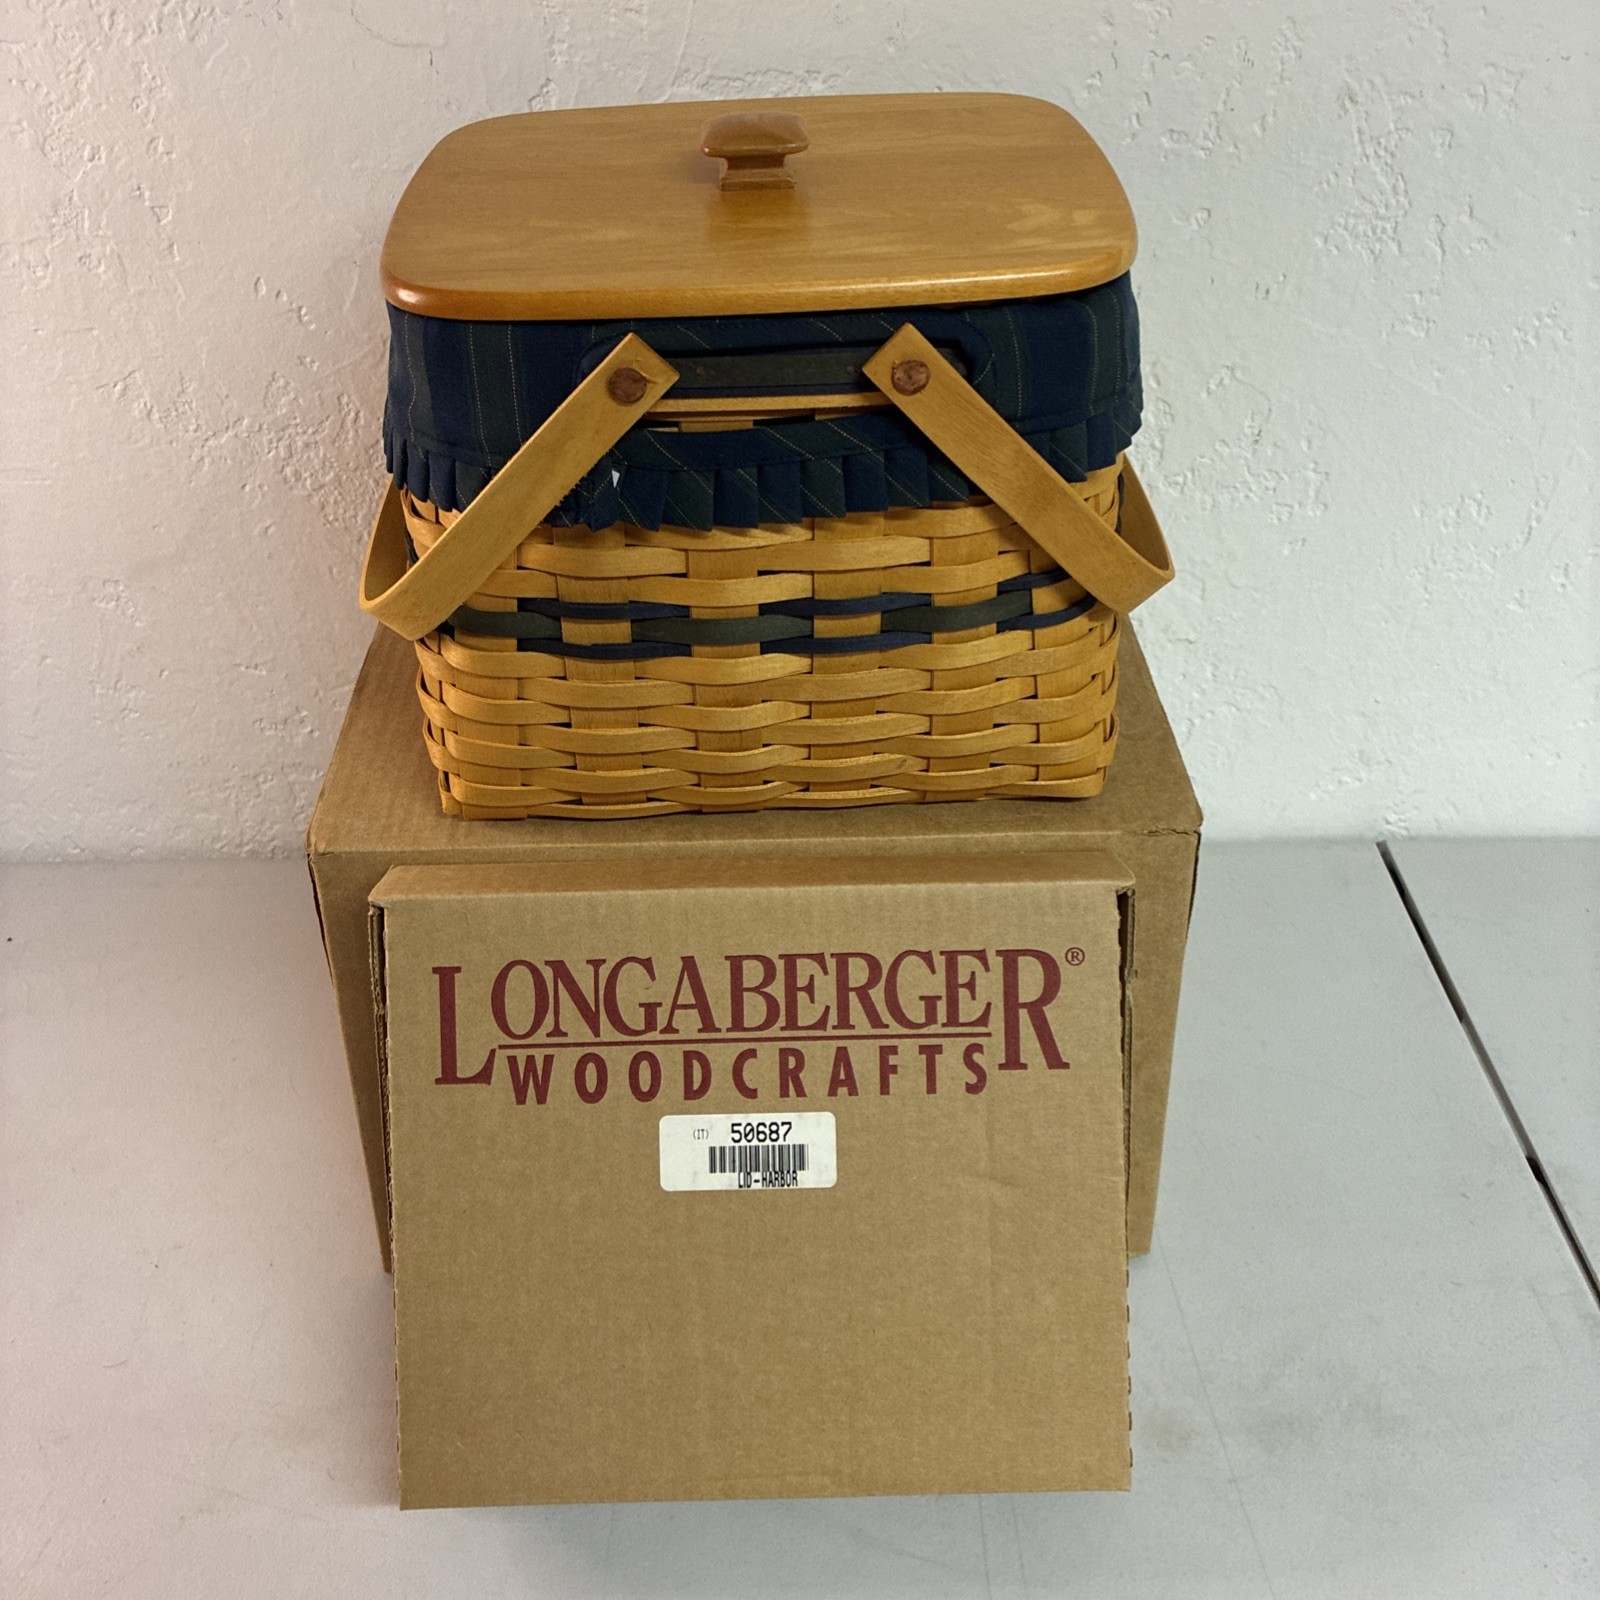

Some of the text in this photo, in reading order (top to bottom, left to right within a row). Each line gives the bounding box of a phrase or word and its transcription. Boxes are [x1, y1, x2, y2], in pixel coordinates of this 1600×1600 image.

[507, 1043, 987, 1105] WOODCRAFTS
[692, 1121, 792, 1143] (IT) 50687
[737, 1170, 798, 1189] LID-HARBOR
